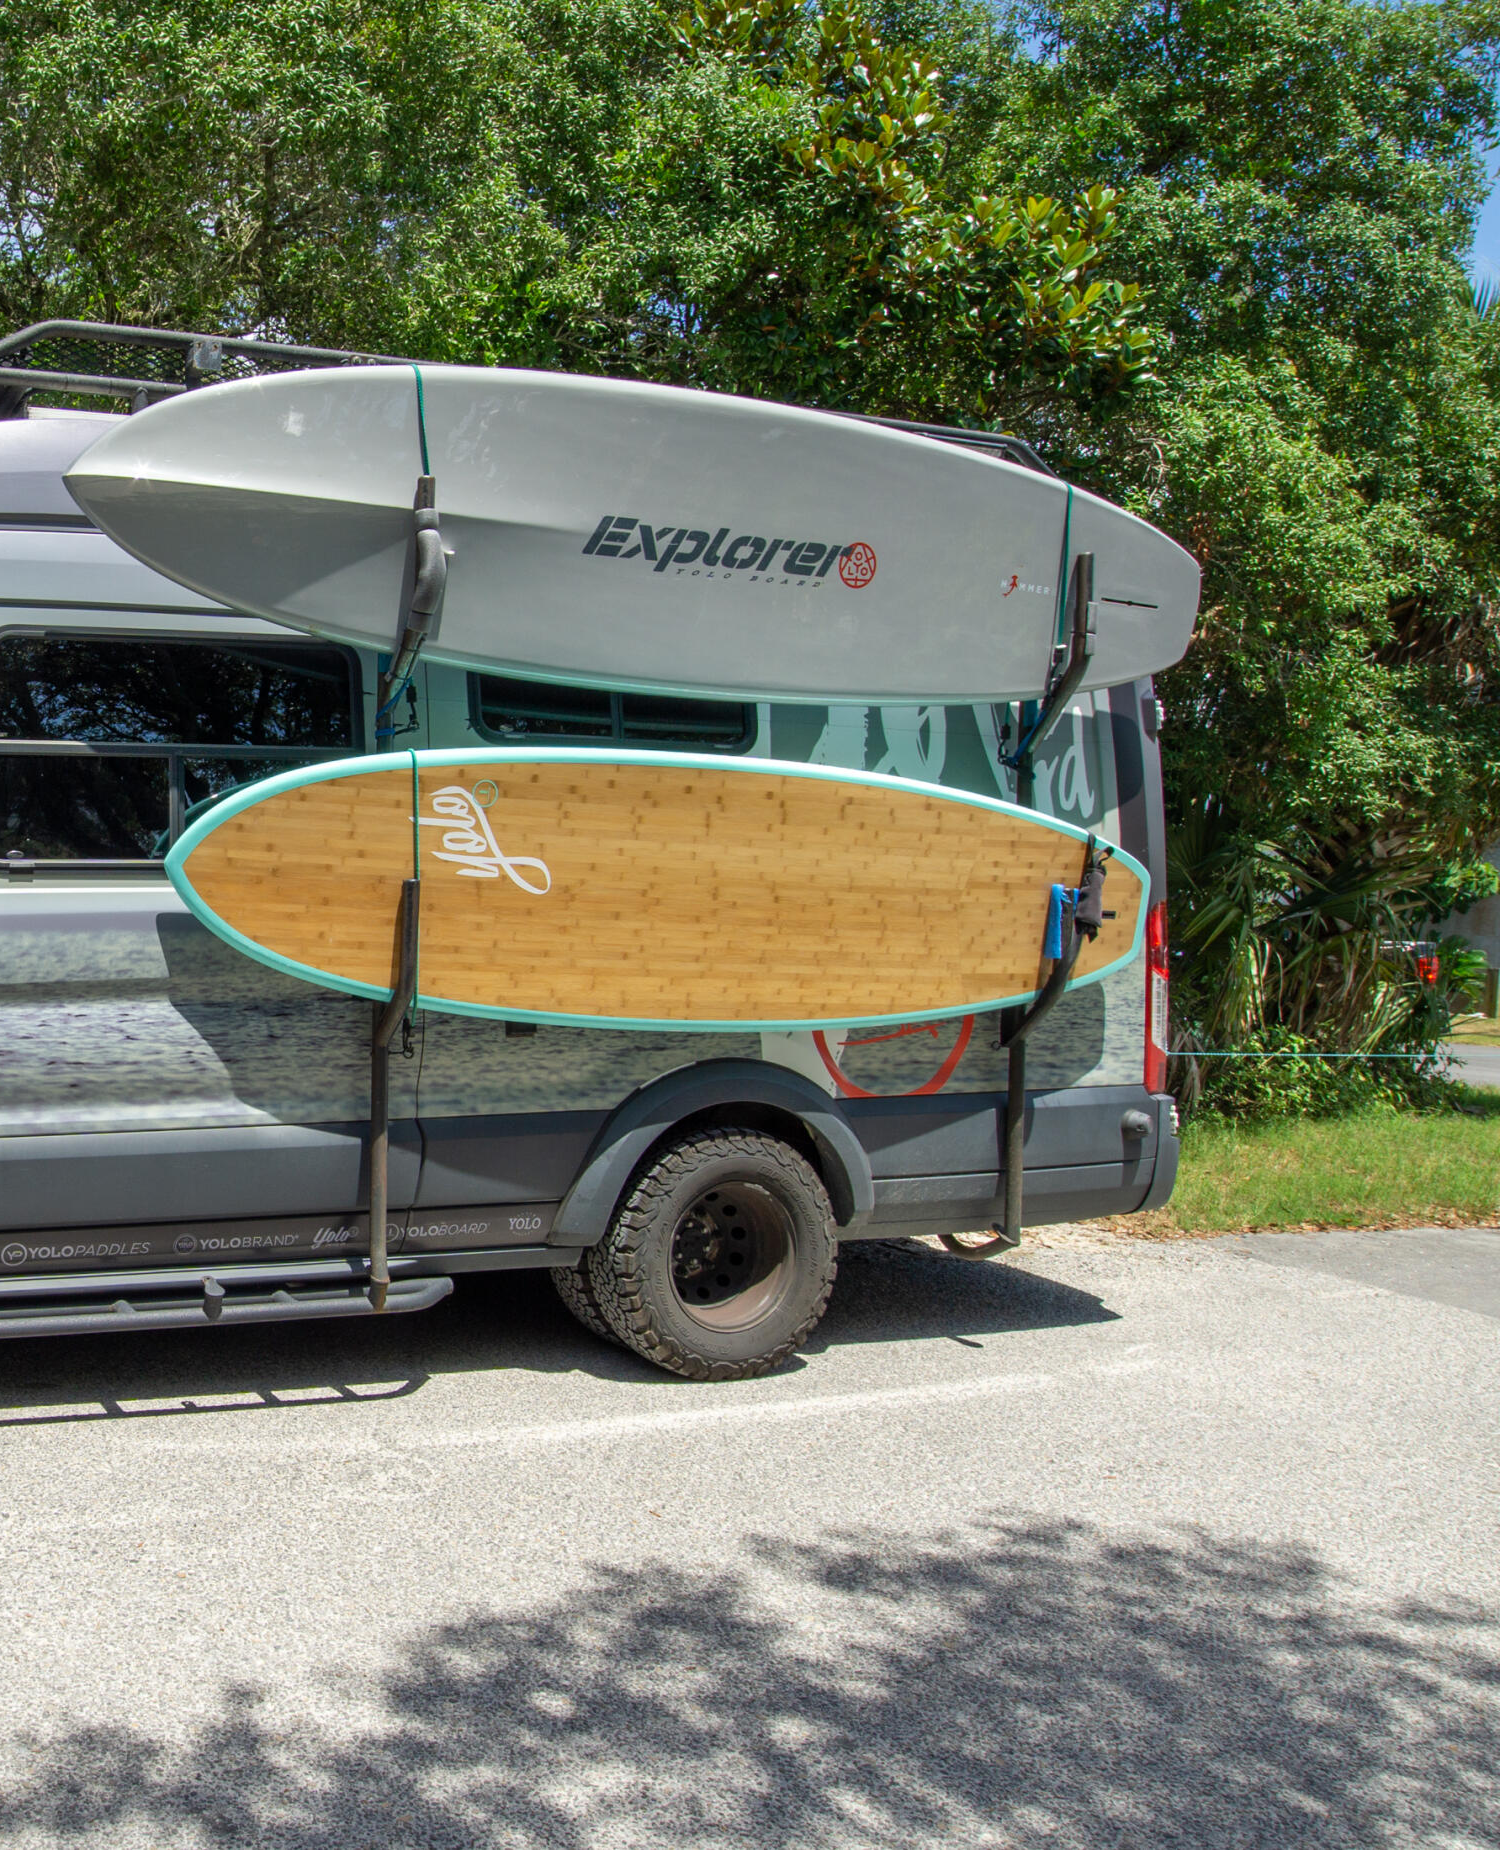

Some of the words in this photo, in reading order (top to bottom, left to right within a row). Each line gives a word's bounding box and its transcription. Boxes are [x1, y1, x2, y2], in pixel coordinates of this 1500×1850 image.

[582, 515, 853, 578] Explorer
[675, 568, 732, 580] YOLO
[749, 575, 824, 588] BOARD
[508, 1217, 542, 1231] YOLO
